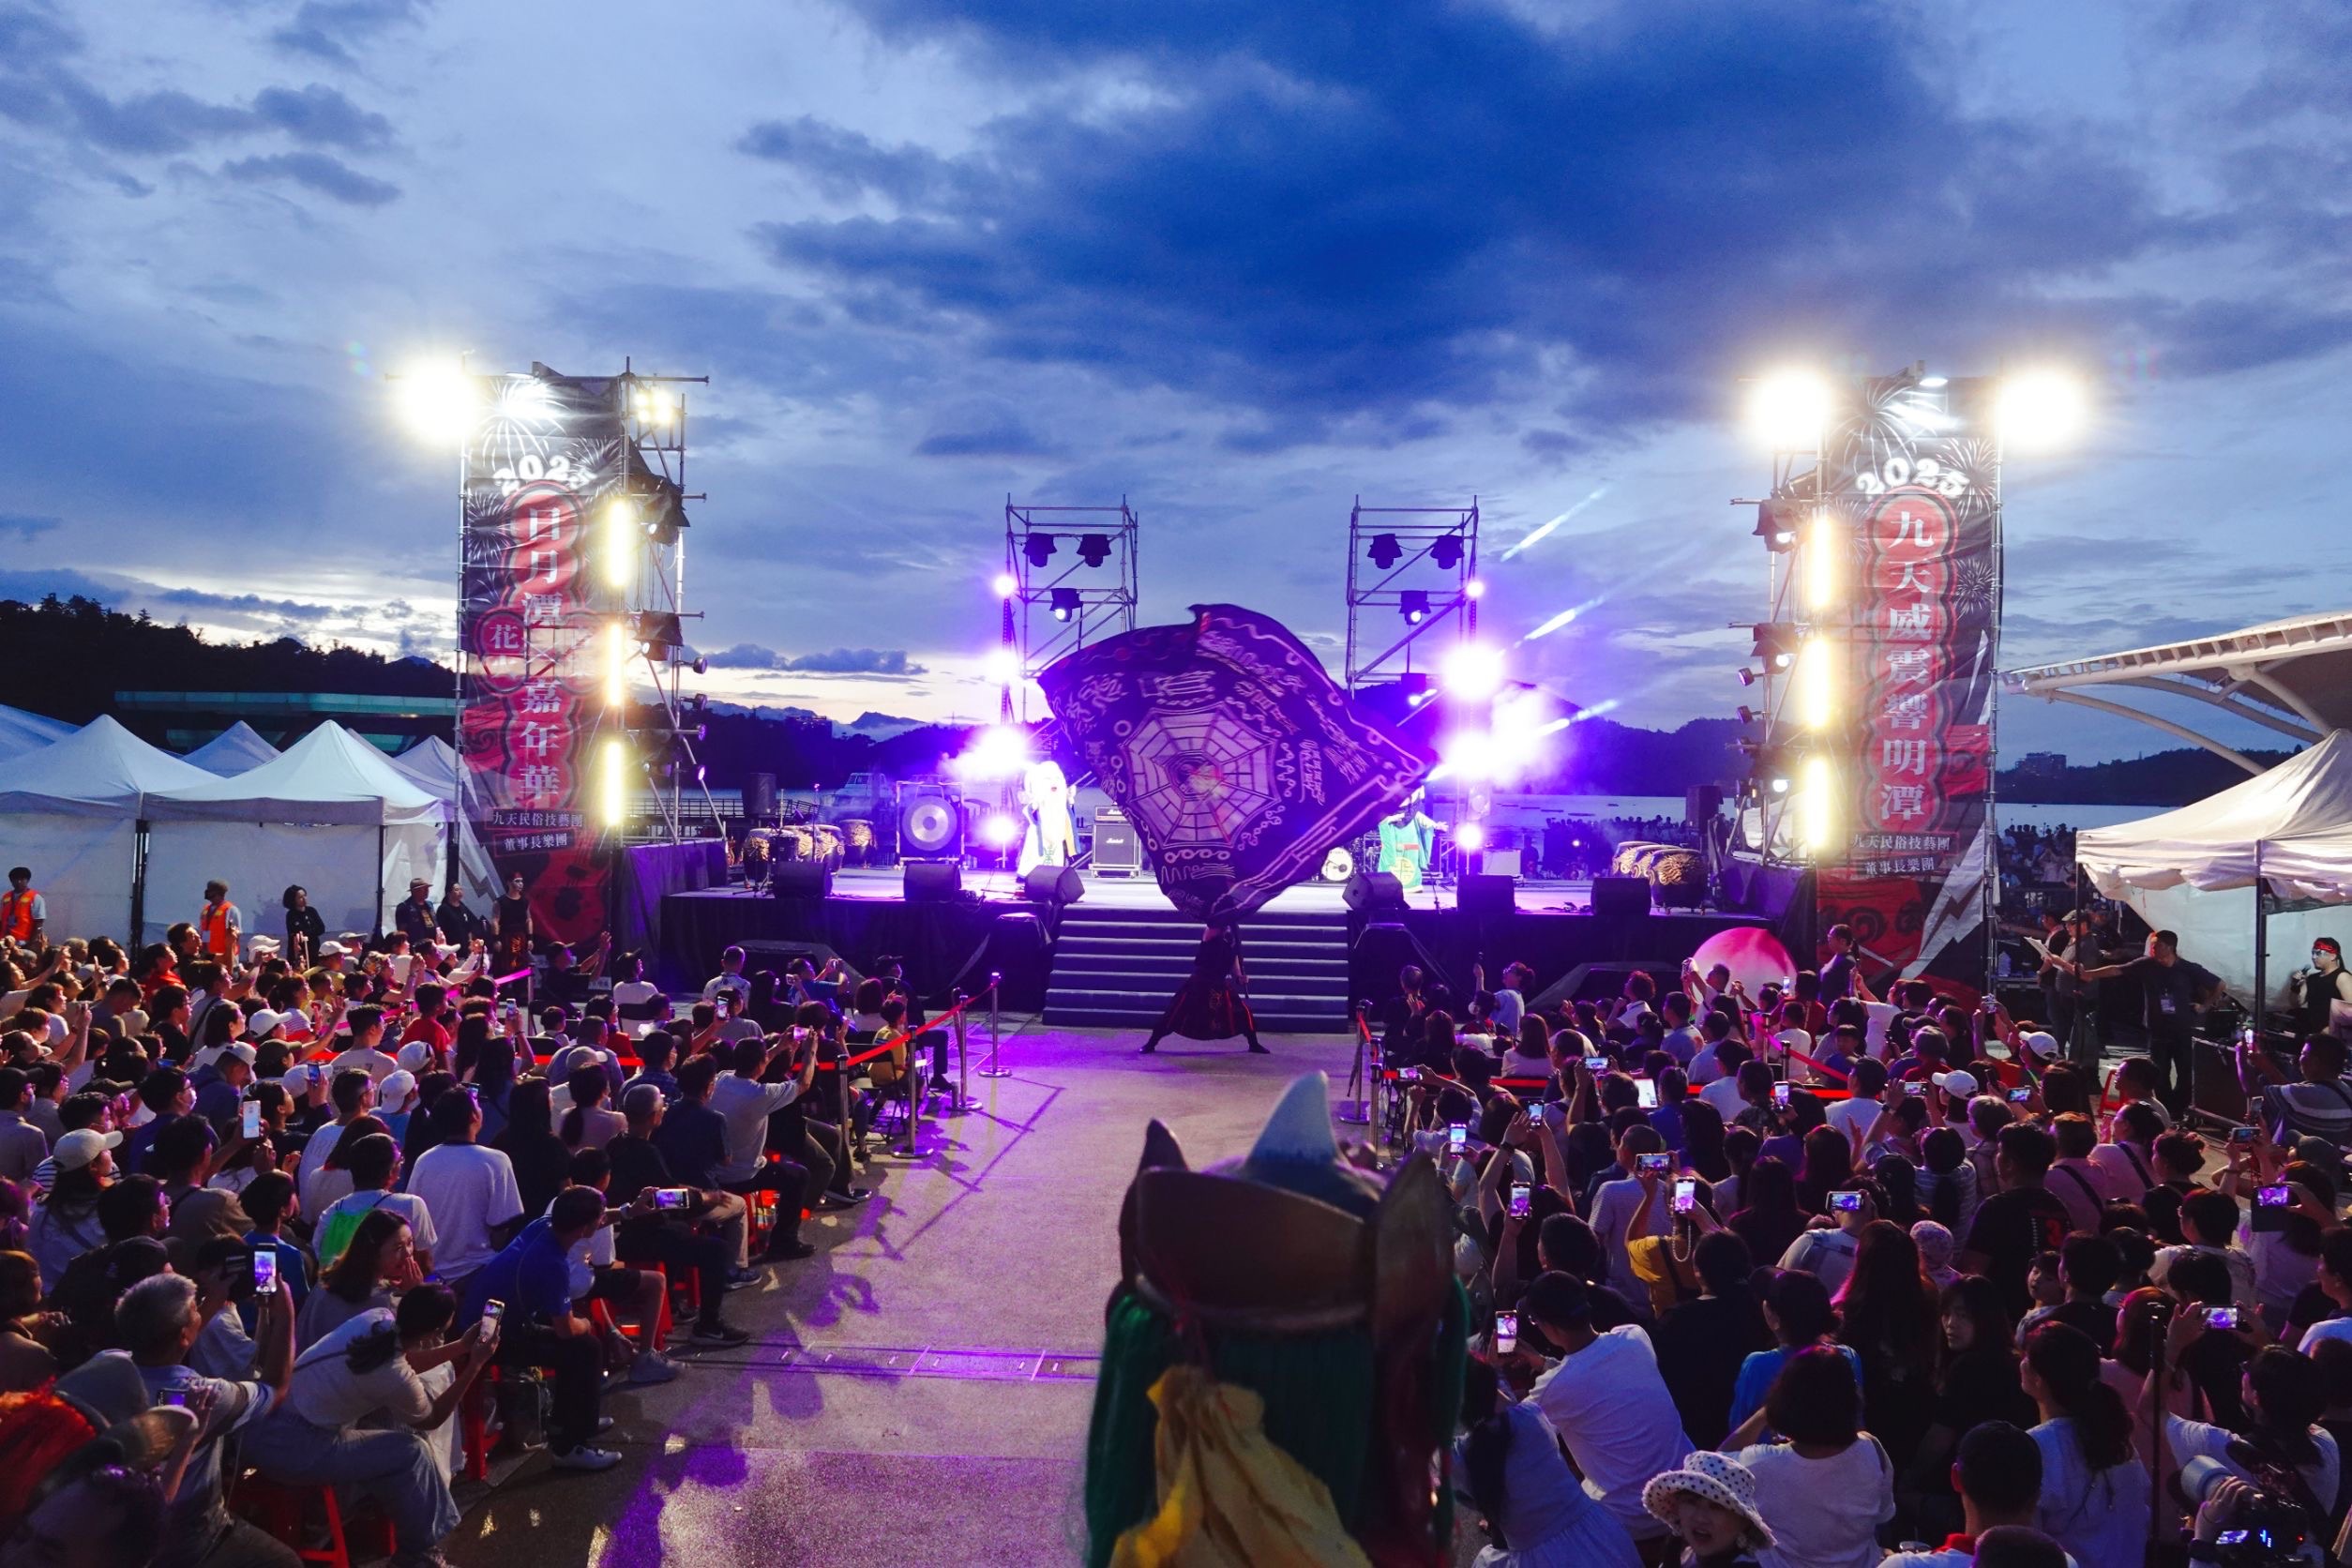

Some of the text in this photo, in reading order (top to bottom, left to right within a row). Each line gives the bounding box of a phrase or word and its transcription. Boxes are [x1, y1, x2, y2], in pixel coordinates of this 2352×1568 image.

[1855, 457, 1970, 502] 2025
[521, 506, 564, 626] 日月潭
[1880, 511, 1936, 821] 九天威震響明潭
[520, 678, 563, 800] 嘉年華
